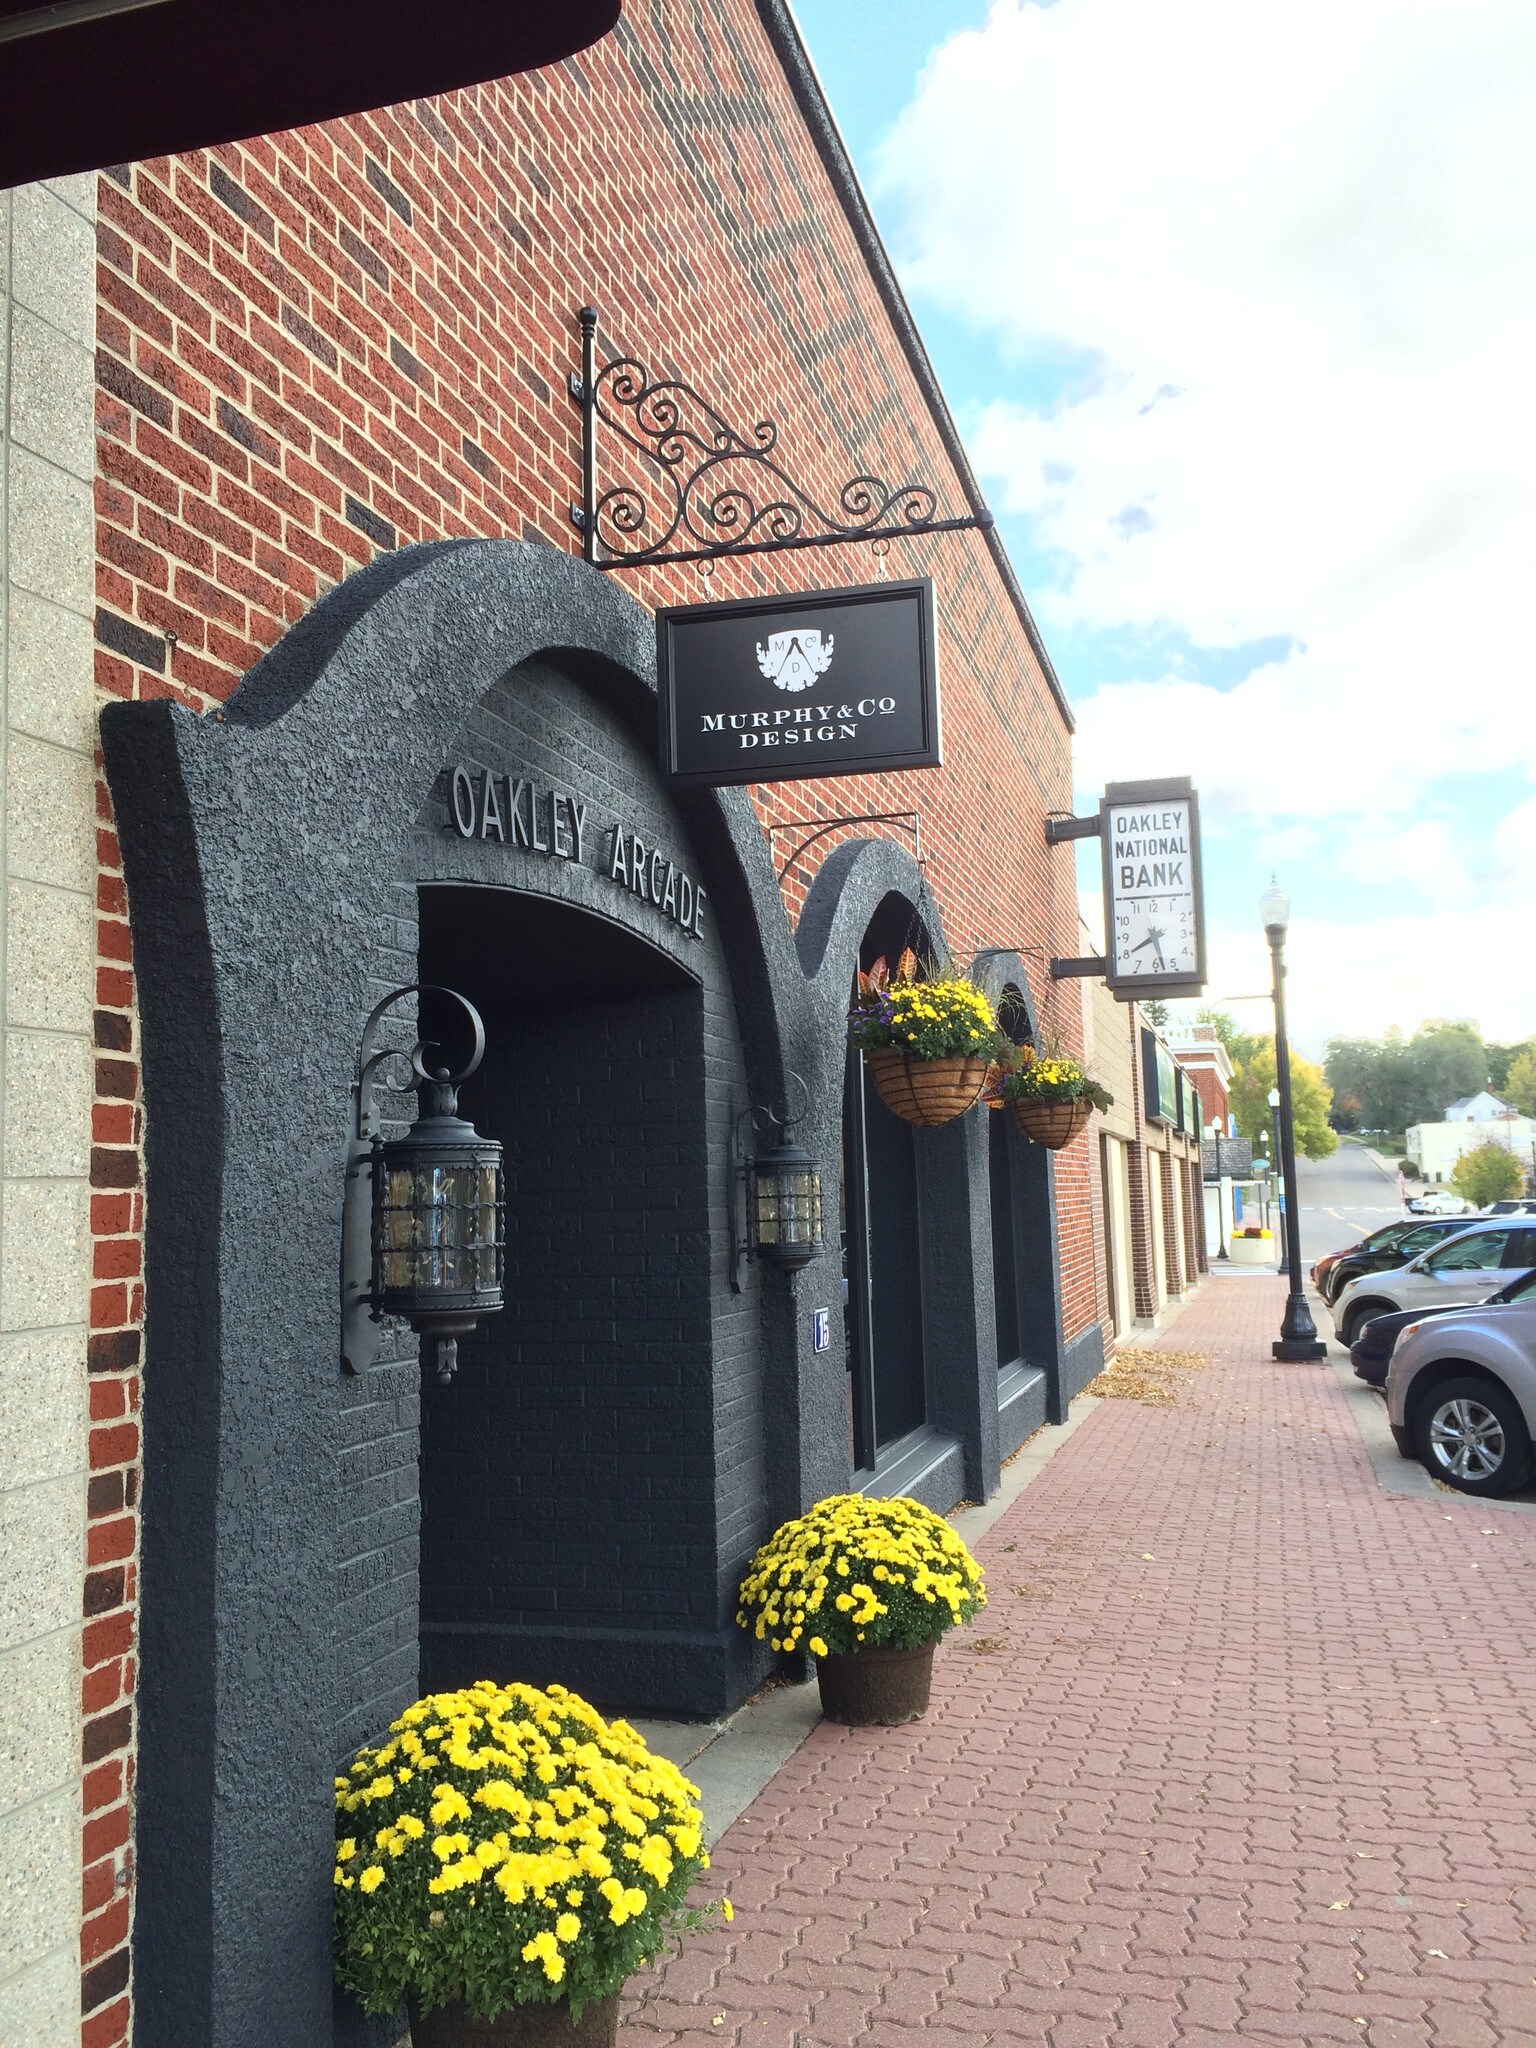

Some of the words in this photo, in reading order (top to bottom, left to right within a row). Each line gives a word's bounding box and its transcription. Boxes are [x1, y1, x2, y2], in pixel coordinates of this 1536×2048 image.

[774, 640, 785, 652] M
[791, 662, 800, 674] D
[739, 723, 858, 749] DESIGN
[1116, 811, 1183, 834] OAKLEY
[450, 765, 586, 863] OAKLEY
[606, 824, 707, 941] ARCADE
[1115, 836, 1188, 859] NATIONAL
[1120, 861, 1184, 890] BANK
[1132, 904, 1141, 914] 11
[1149, 903, 1159, 913] 12
[1120, 916, 1130, 926] 10
[1180, 912, 1187, 923] 2
[1122, 933, 1130, 944] 9
[1180, 929, 1188, 939] 3
[1122, 949, 1131, 960] 8
[1181, 946, 1189, 956] 4
[1134, 960, 1143, 970] 7
[1152, 958, 1160, 969] 6
[1169, 958, 1177, 968] 5
[818, 1312, 830, 1349] 15
